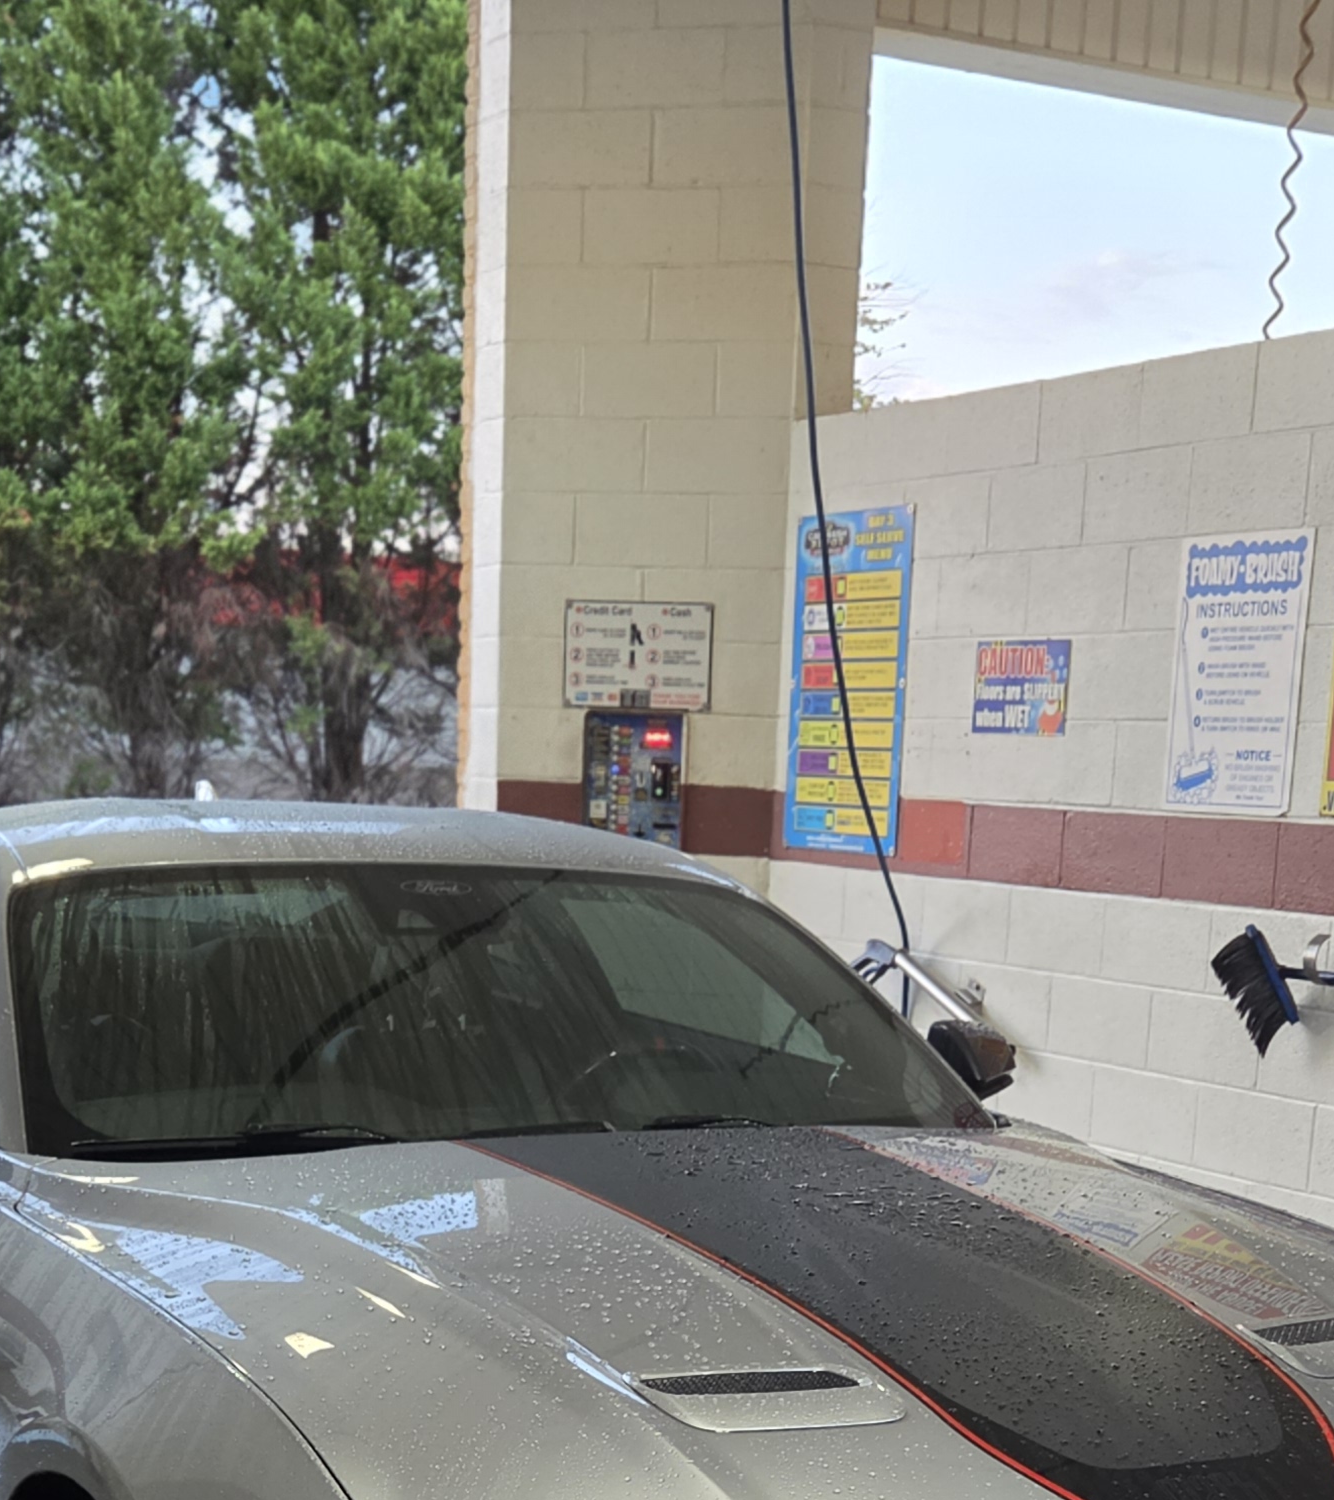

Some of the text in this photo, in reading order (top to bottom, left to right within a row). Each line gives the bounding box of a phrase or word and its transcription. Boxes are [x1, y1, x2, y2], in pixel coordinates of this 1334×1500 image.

[1196, 600, 1288, 619] INSTRUCTIONS
[1006, 686, 1021, 700] are
[976, 705, 1030, 728] when WET
[1236, 749, 1271, 762] NOTICE
